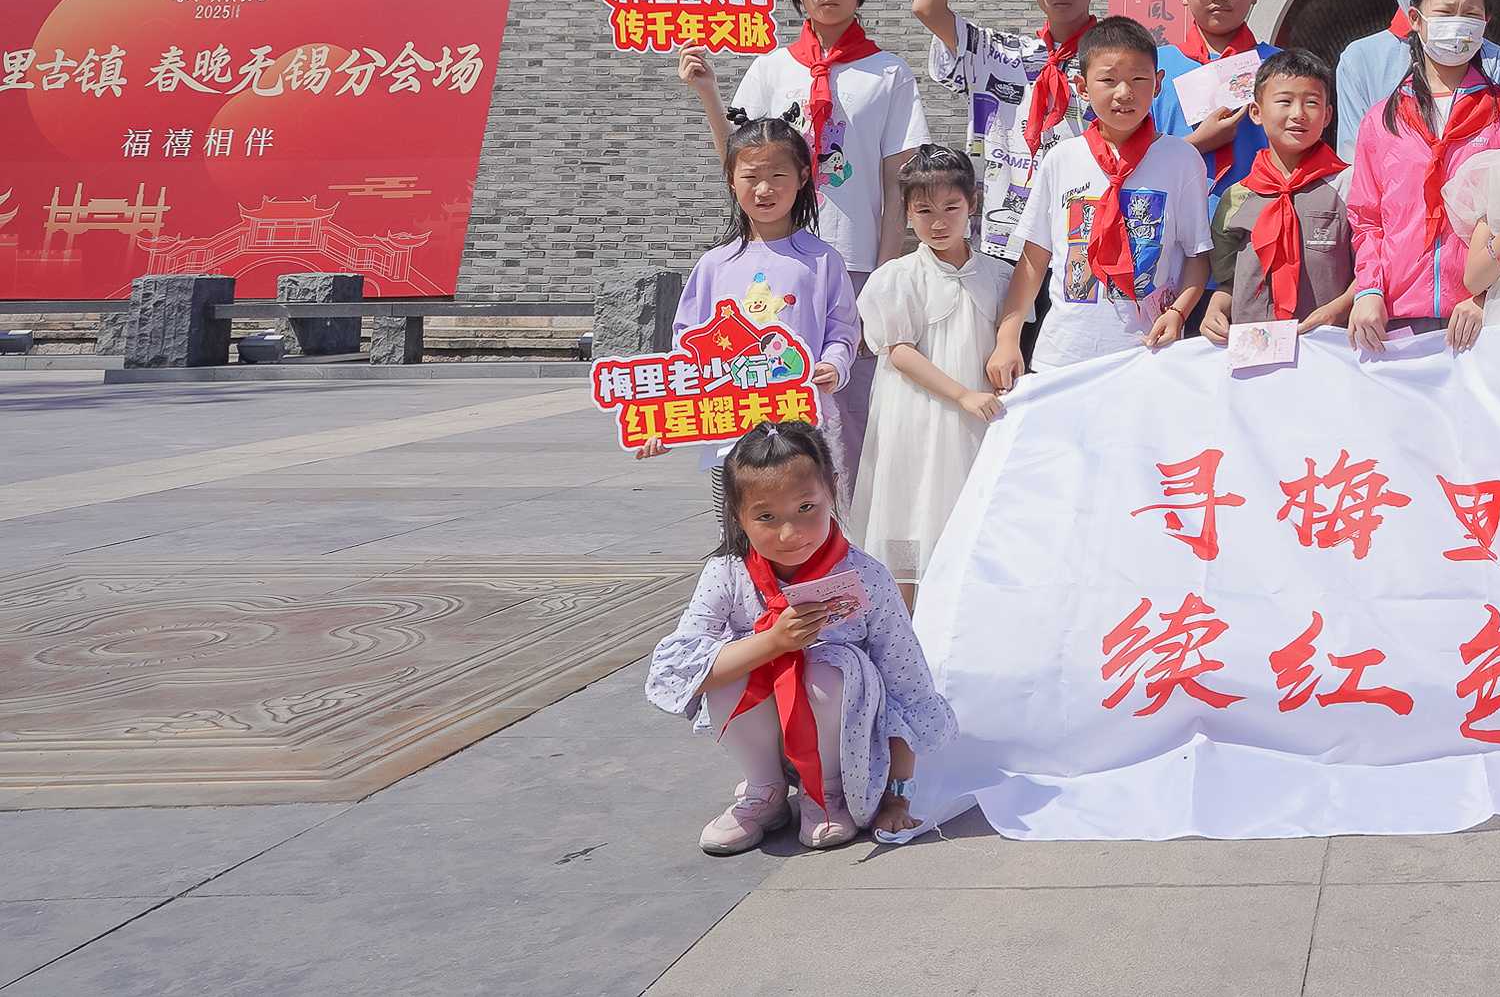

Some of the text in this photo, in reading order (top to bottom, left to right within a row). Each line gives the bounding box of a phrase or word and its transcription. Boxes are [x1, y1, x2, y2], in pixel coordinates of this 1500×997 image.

[616, 8, 771, 47] 传千年文脉
[145, 41, 485, 97] 春晚无锡分会场
[120, 127, 275, 158] 福禧相伴
[599, 354, 769, 403] 梅里老少行
[624, 389, 813, 442] 红星耀未来
